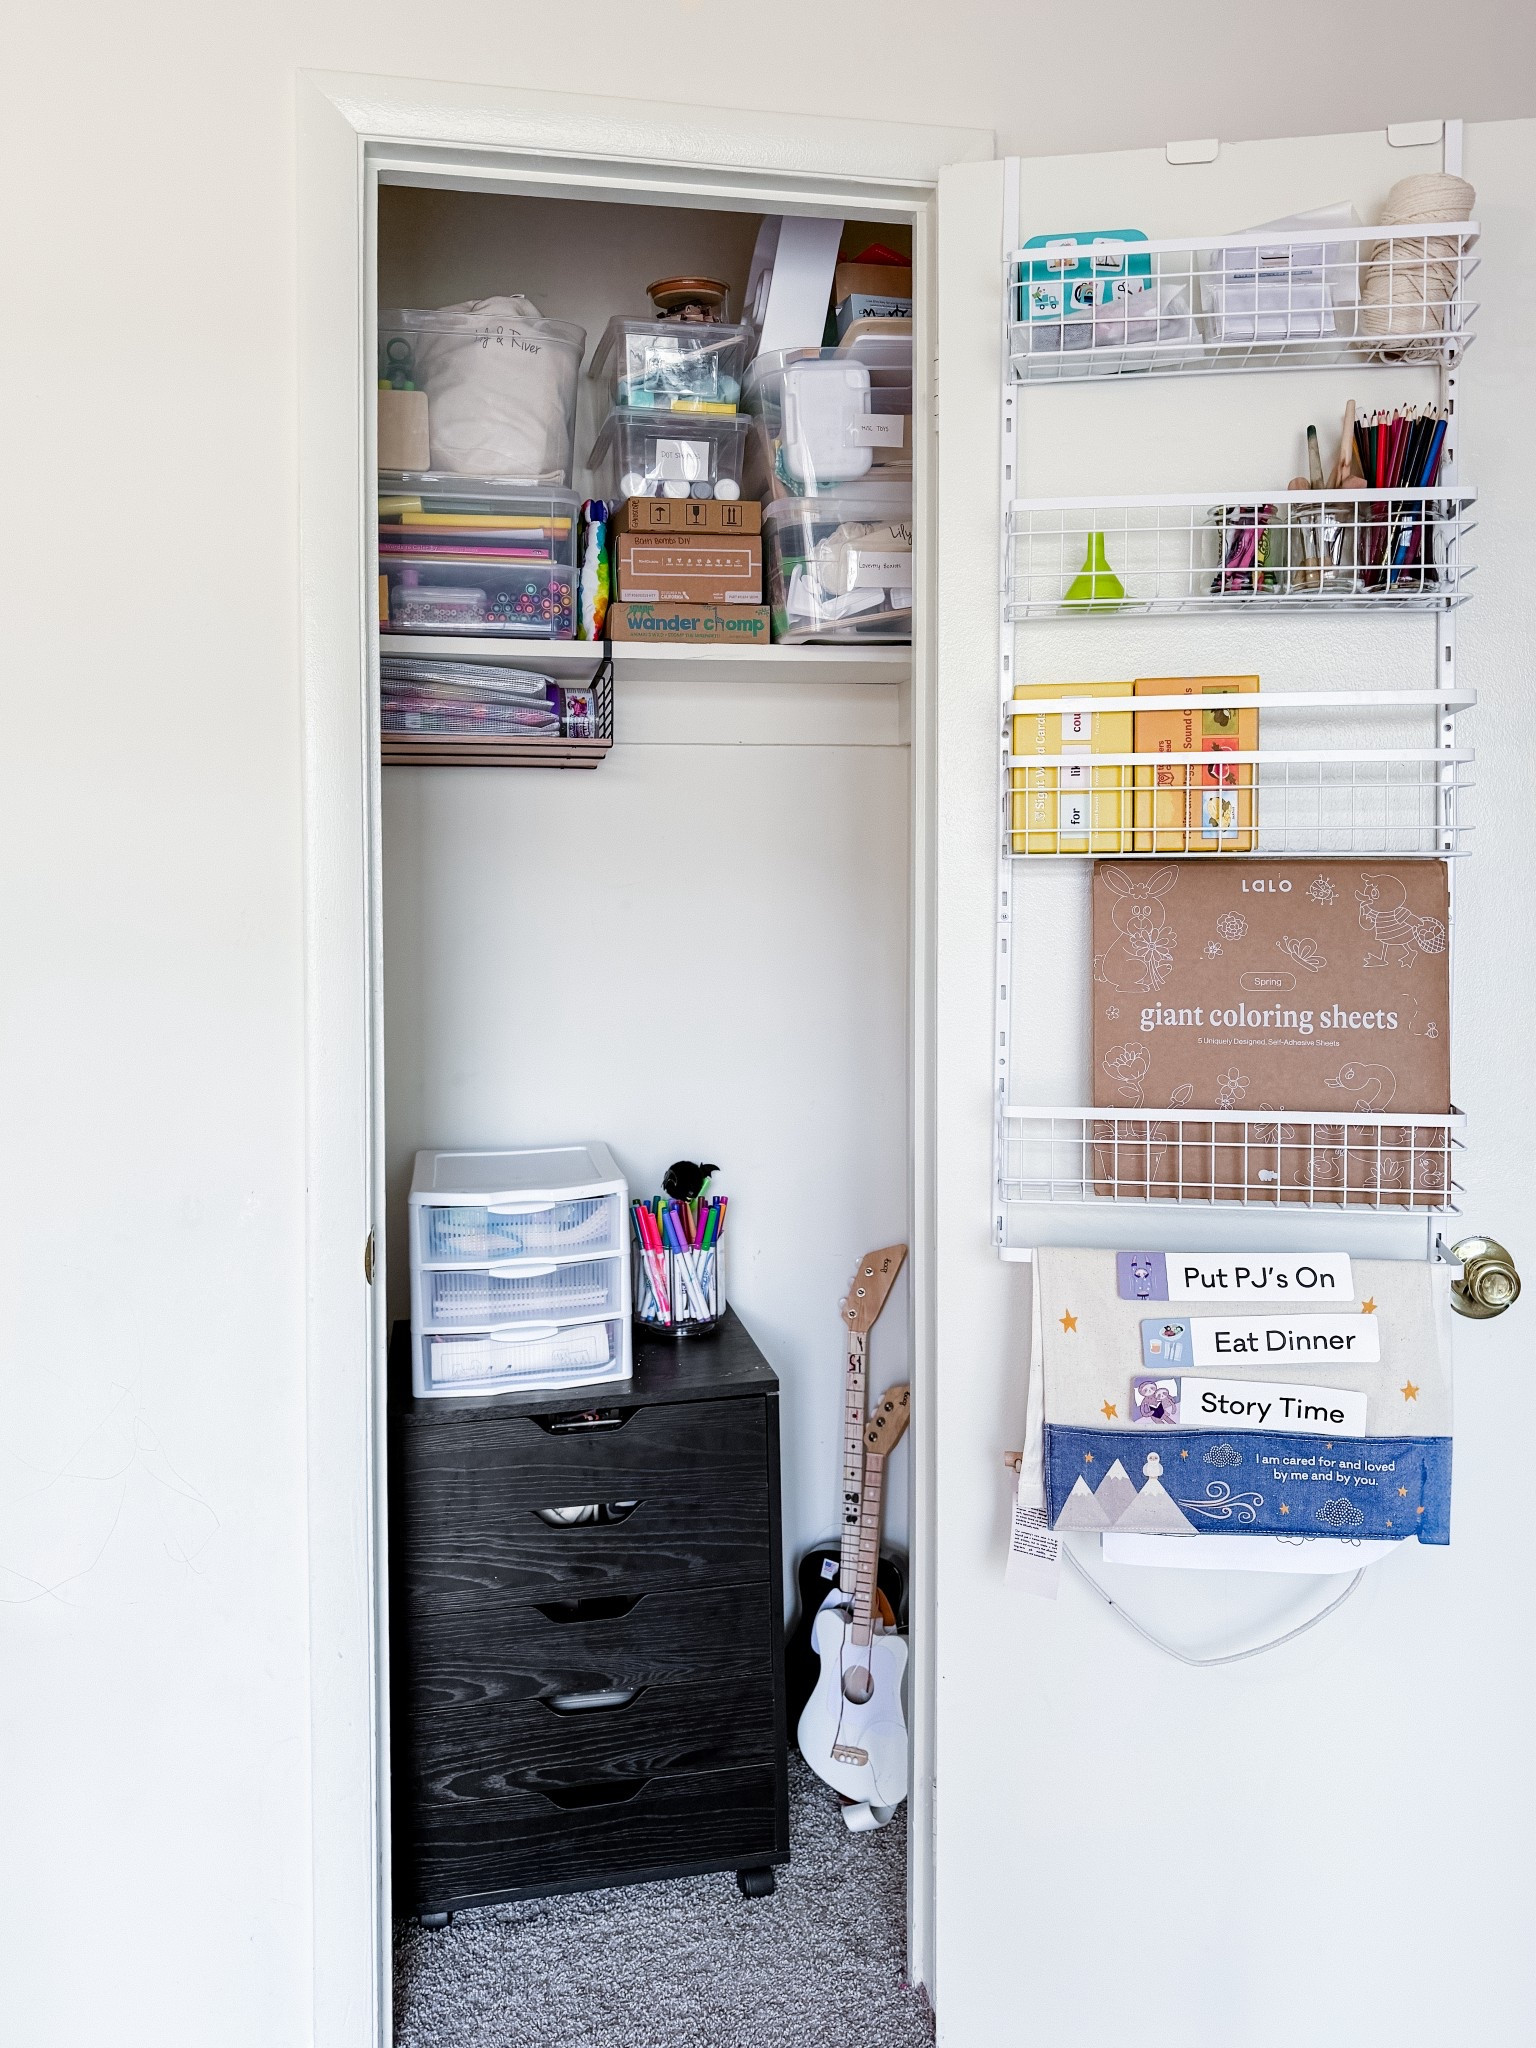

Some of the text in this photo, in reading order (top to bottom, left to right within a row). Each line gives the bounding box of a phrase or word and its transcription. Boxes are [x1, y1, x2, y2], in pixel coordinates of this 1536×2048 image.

[508, 328, 542, 355] River
[678, 537, 691, 545] DIY
[888, 523, 912, 545] Lily
[627, 610, 765, 638] wander chomp
[1184, 718, 1193, 749] Sound
[1035, 747, 1046, 777] Wd
[1070, 765, 1081, 777] lik
[1070, 808, 1081, 825] for
[1253, 977, 1282, 987] Spring
[1139, 1001, 1399, 1034] giant coloring sheets
[1203, 1037, 1233, 1046] Uniquely
[1267, 1039, 1315, 1047] Self-Adhesive
[1315, 1039, 1340, 1047] Sheets
[1184, 1266, 1336, 1289] Put PJ's On
[1214, 1330, 1356, 1353] Eat Dinner
[1201, 1391, 1345, 1424] Story Time
[1261, 1456, 1280, 1465] am
[1282, 1455, 1316, 1466] cared
[1317, 1456, 1337, 1468] for
[1338, 1459, 1361, 1470] and
[1364, 1460, 1396, 1472] loved
[1273, 1468, 1379, 1487] by me and by you.
